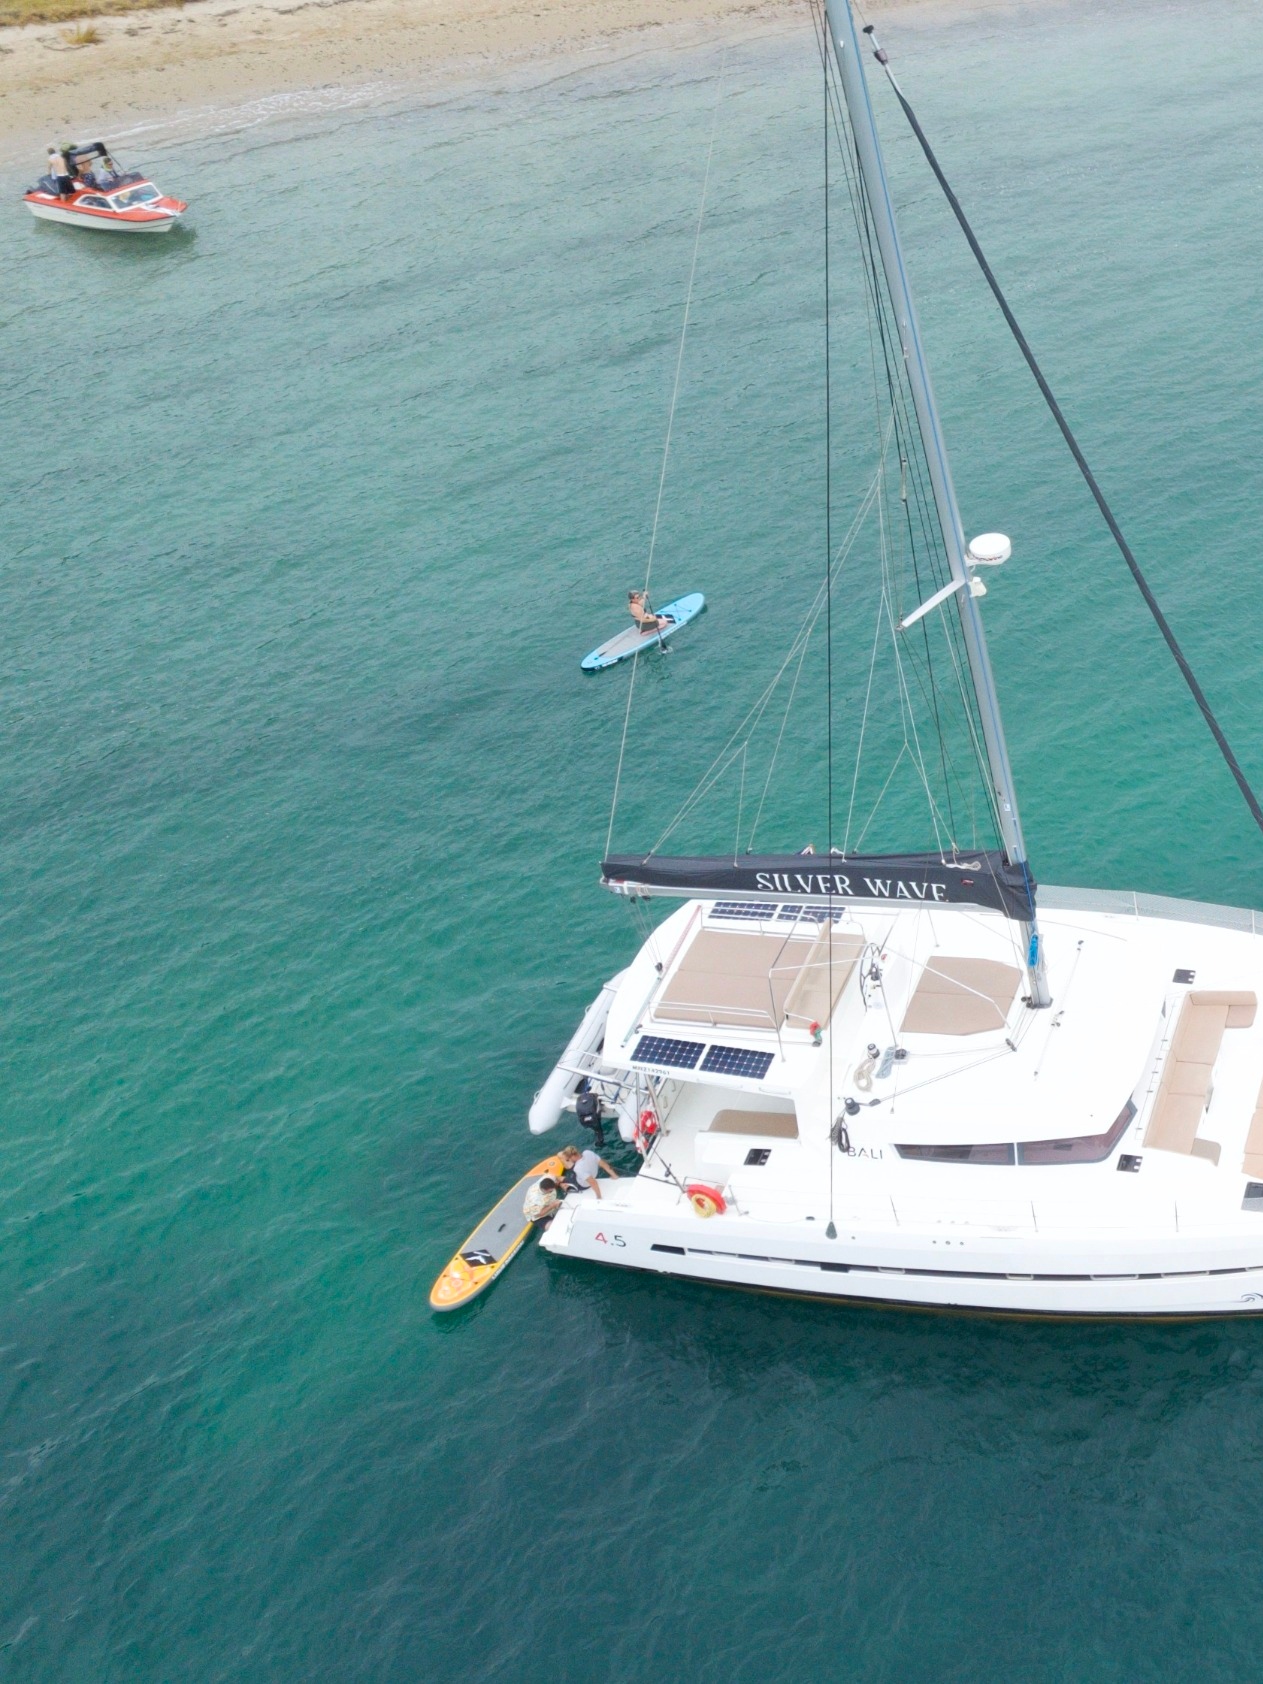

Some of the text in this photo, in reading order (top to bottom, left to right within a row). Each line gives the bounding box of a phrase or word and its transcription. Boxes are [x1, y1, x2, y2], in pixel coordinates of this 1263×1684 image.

[756, 872, 855, 896] SILVER
[847, 1147, 883, 1160] BALI
[595, 1232, 627, 1248] 4.5
